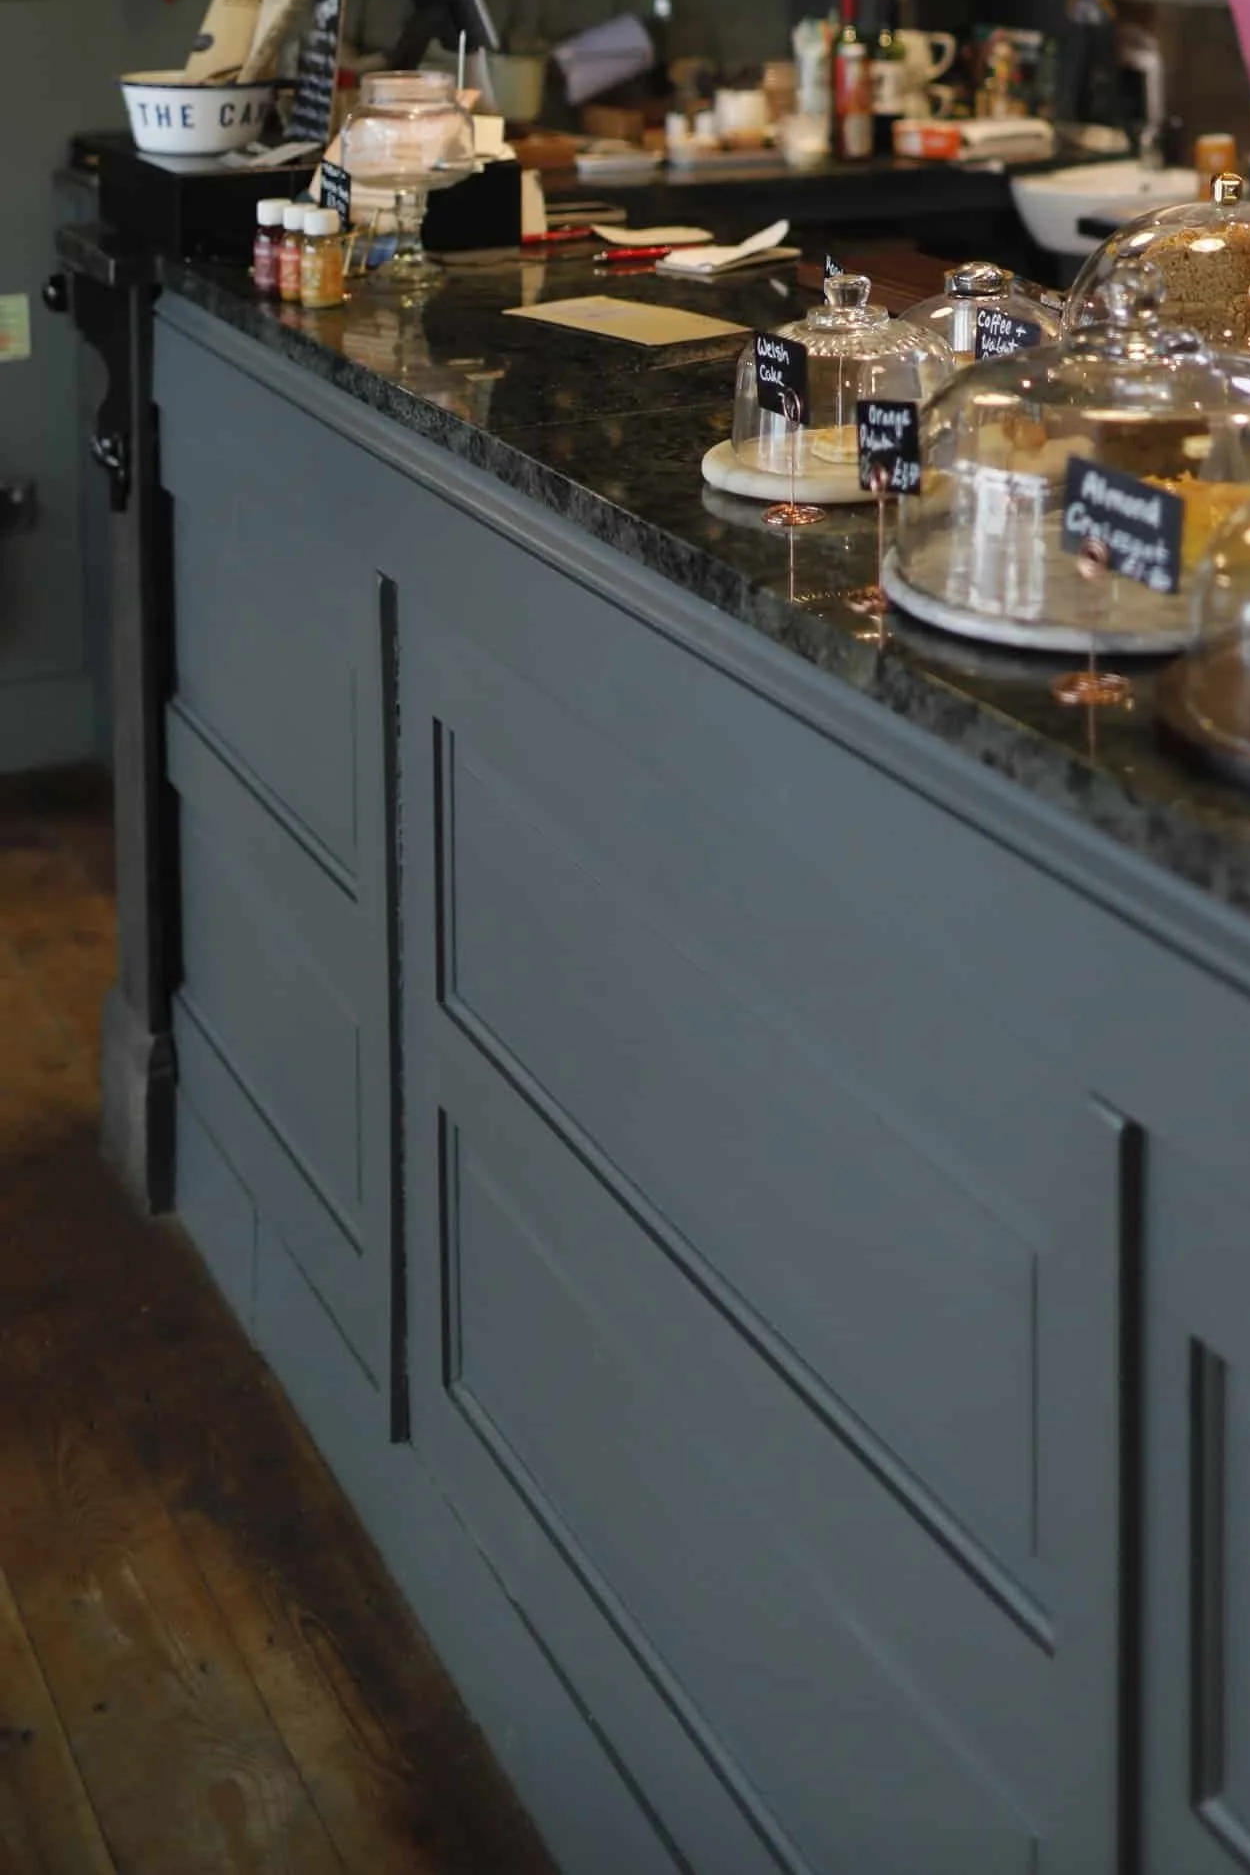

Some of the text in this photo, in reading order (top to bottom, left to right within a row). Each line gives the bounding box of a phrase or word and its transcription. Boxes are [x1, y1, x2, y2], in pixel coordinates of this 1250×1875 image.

[137, 103, 196, 129] THE
[978, 310, 1012, 336] Coffee
[757, 336, 790, 366] Welsh
[759, 364, 785, 388] Cake
[868, 404, 912, 439] Orange
[1081, 470, 1162, 530] Almond
